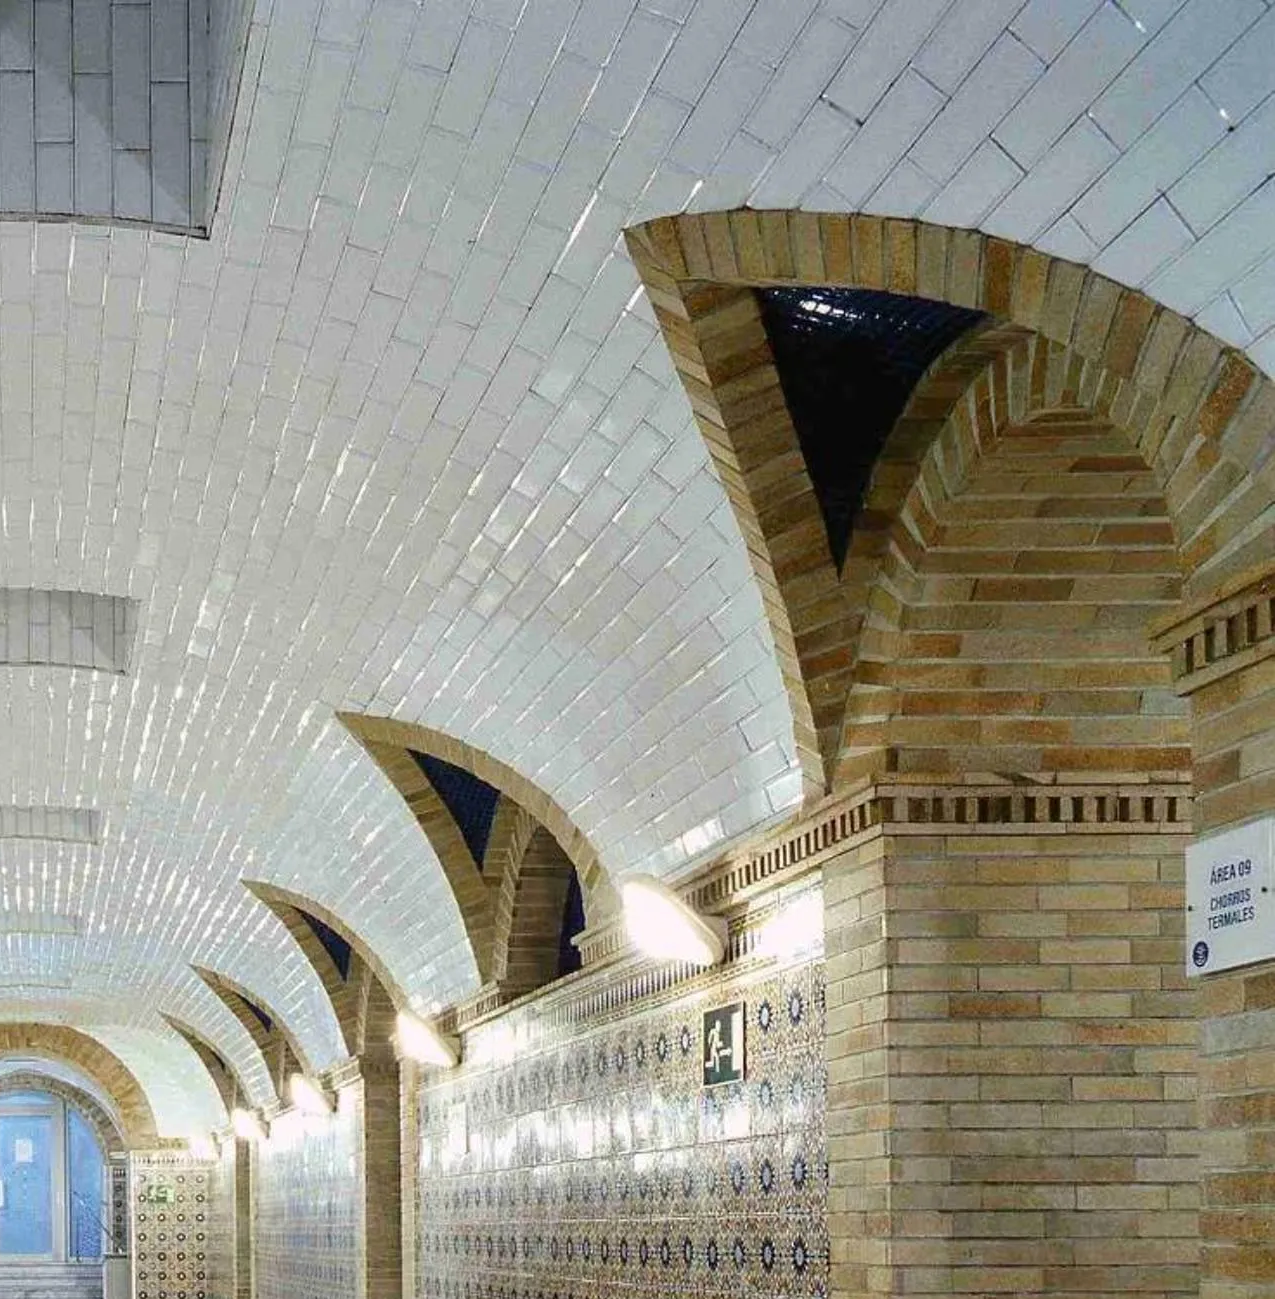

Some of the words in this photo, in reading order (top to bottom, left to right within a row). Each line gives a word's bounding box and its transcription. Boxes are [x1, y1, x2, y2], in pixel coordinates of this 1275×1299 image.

[1210, 864, 1236, 885] ÁREA
[1238, 859, 1252, 876] 09
[1210, 888, 1251, 911] CHORROS
[1208, 906, 1254, 931] TERMALES
